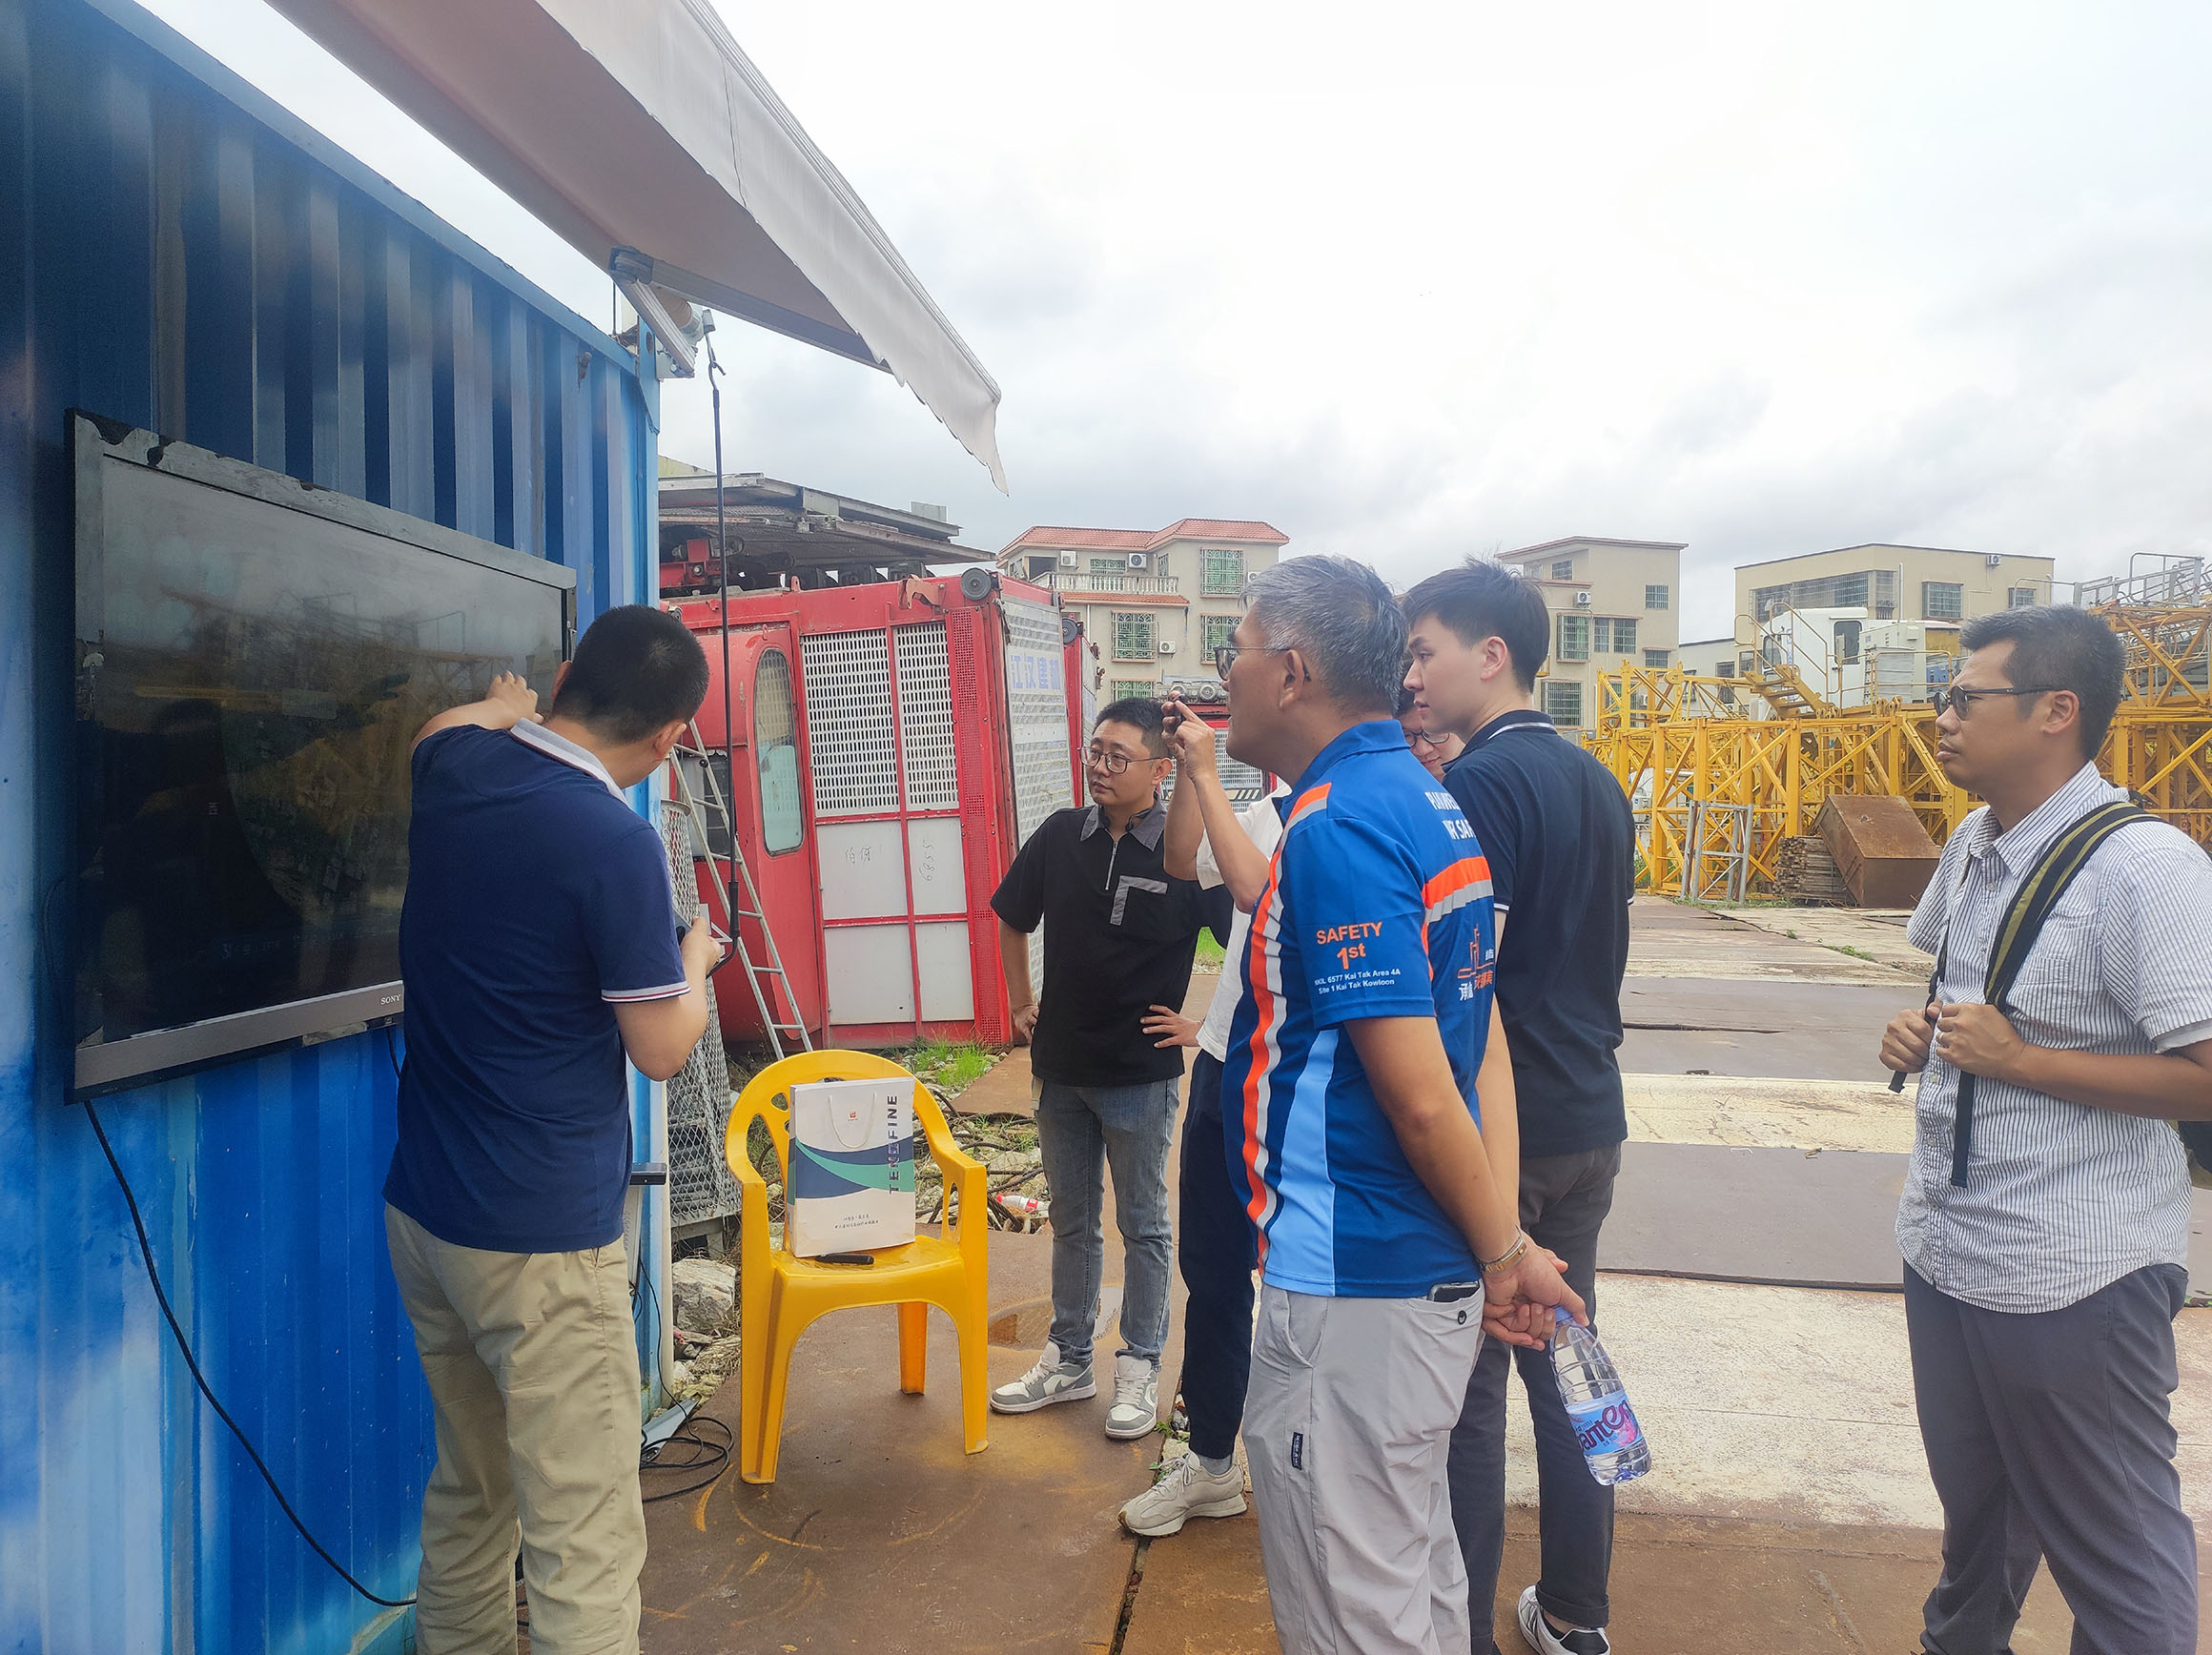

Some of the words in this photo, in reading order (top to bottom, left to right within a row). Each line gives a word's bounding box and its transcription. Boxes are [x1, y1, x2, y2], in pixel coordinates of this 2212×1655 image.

[1316, 921, 1382, 945] SAFETY
[1337, 943, 1366, 970] 1st
[1327, 973, 1343, 984] 6577
[1344, 972, 1357, 981] Kai
[1372, 969, 1390, 977] Area
[1390, 968, 1402, 976] 4A
[1336, 983, 1347, 991] Kai
[1348, 980, 1362, 989] Tak
[1362, 978, 1395, 988] Kowloon
[380, 994, 401, 1006] SONY
